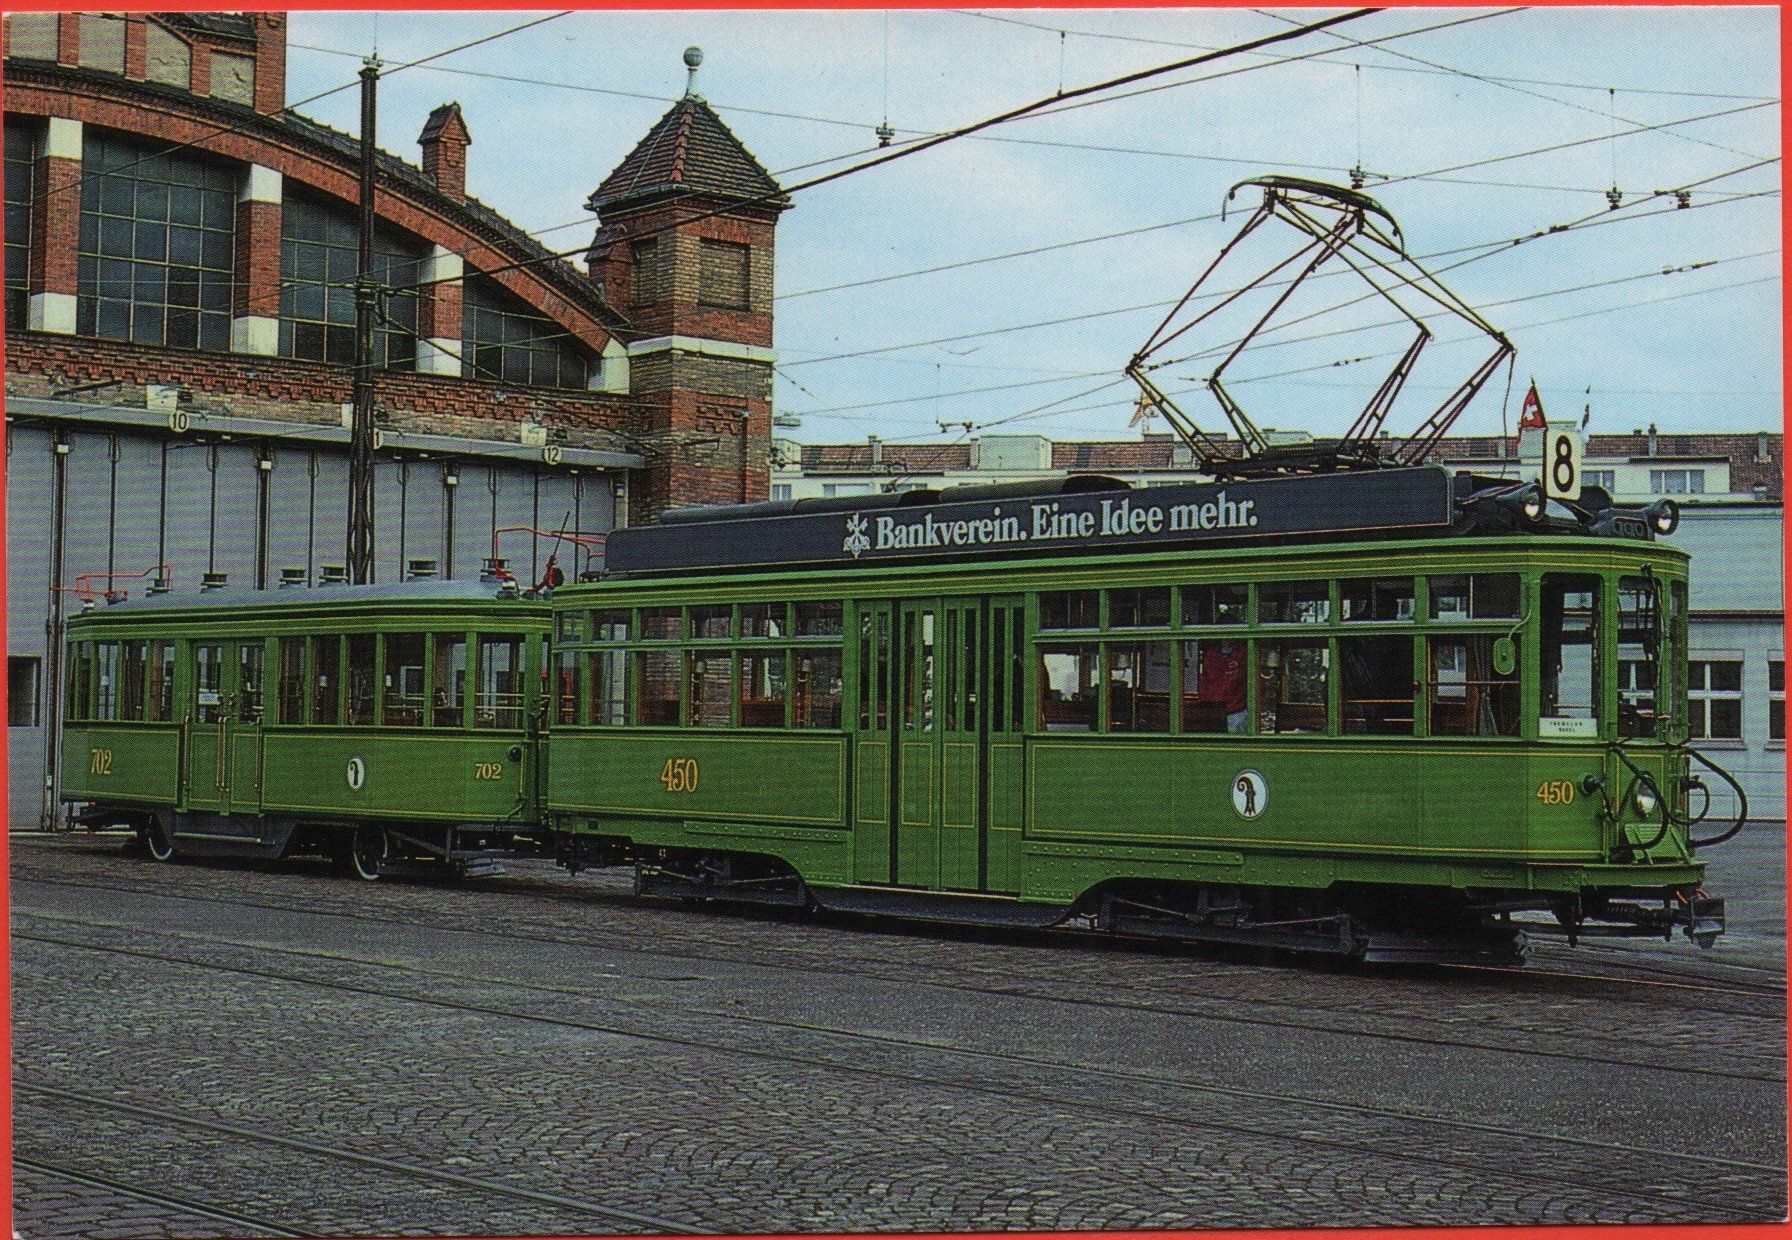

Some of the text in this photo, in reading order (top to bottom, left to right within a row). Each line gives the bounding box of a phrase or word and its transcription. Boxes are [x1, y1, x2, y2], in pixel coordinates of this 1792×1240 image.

[172, 412, 188, 430] 10
[547, 446, 560, 462] 12
[1553, 435, 1575, 493] 8
[875, 490, 1258, 550] Bankverein. Eine Idee mehr.
[91, 748, 112, 776] 702
[475, 763, 502, 780] 702
[660, 758, 699, 793] 450
[1536, 780, 1574, 805] 450
